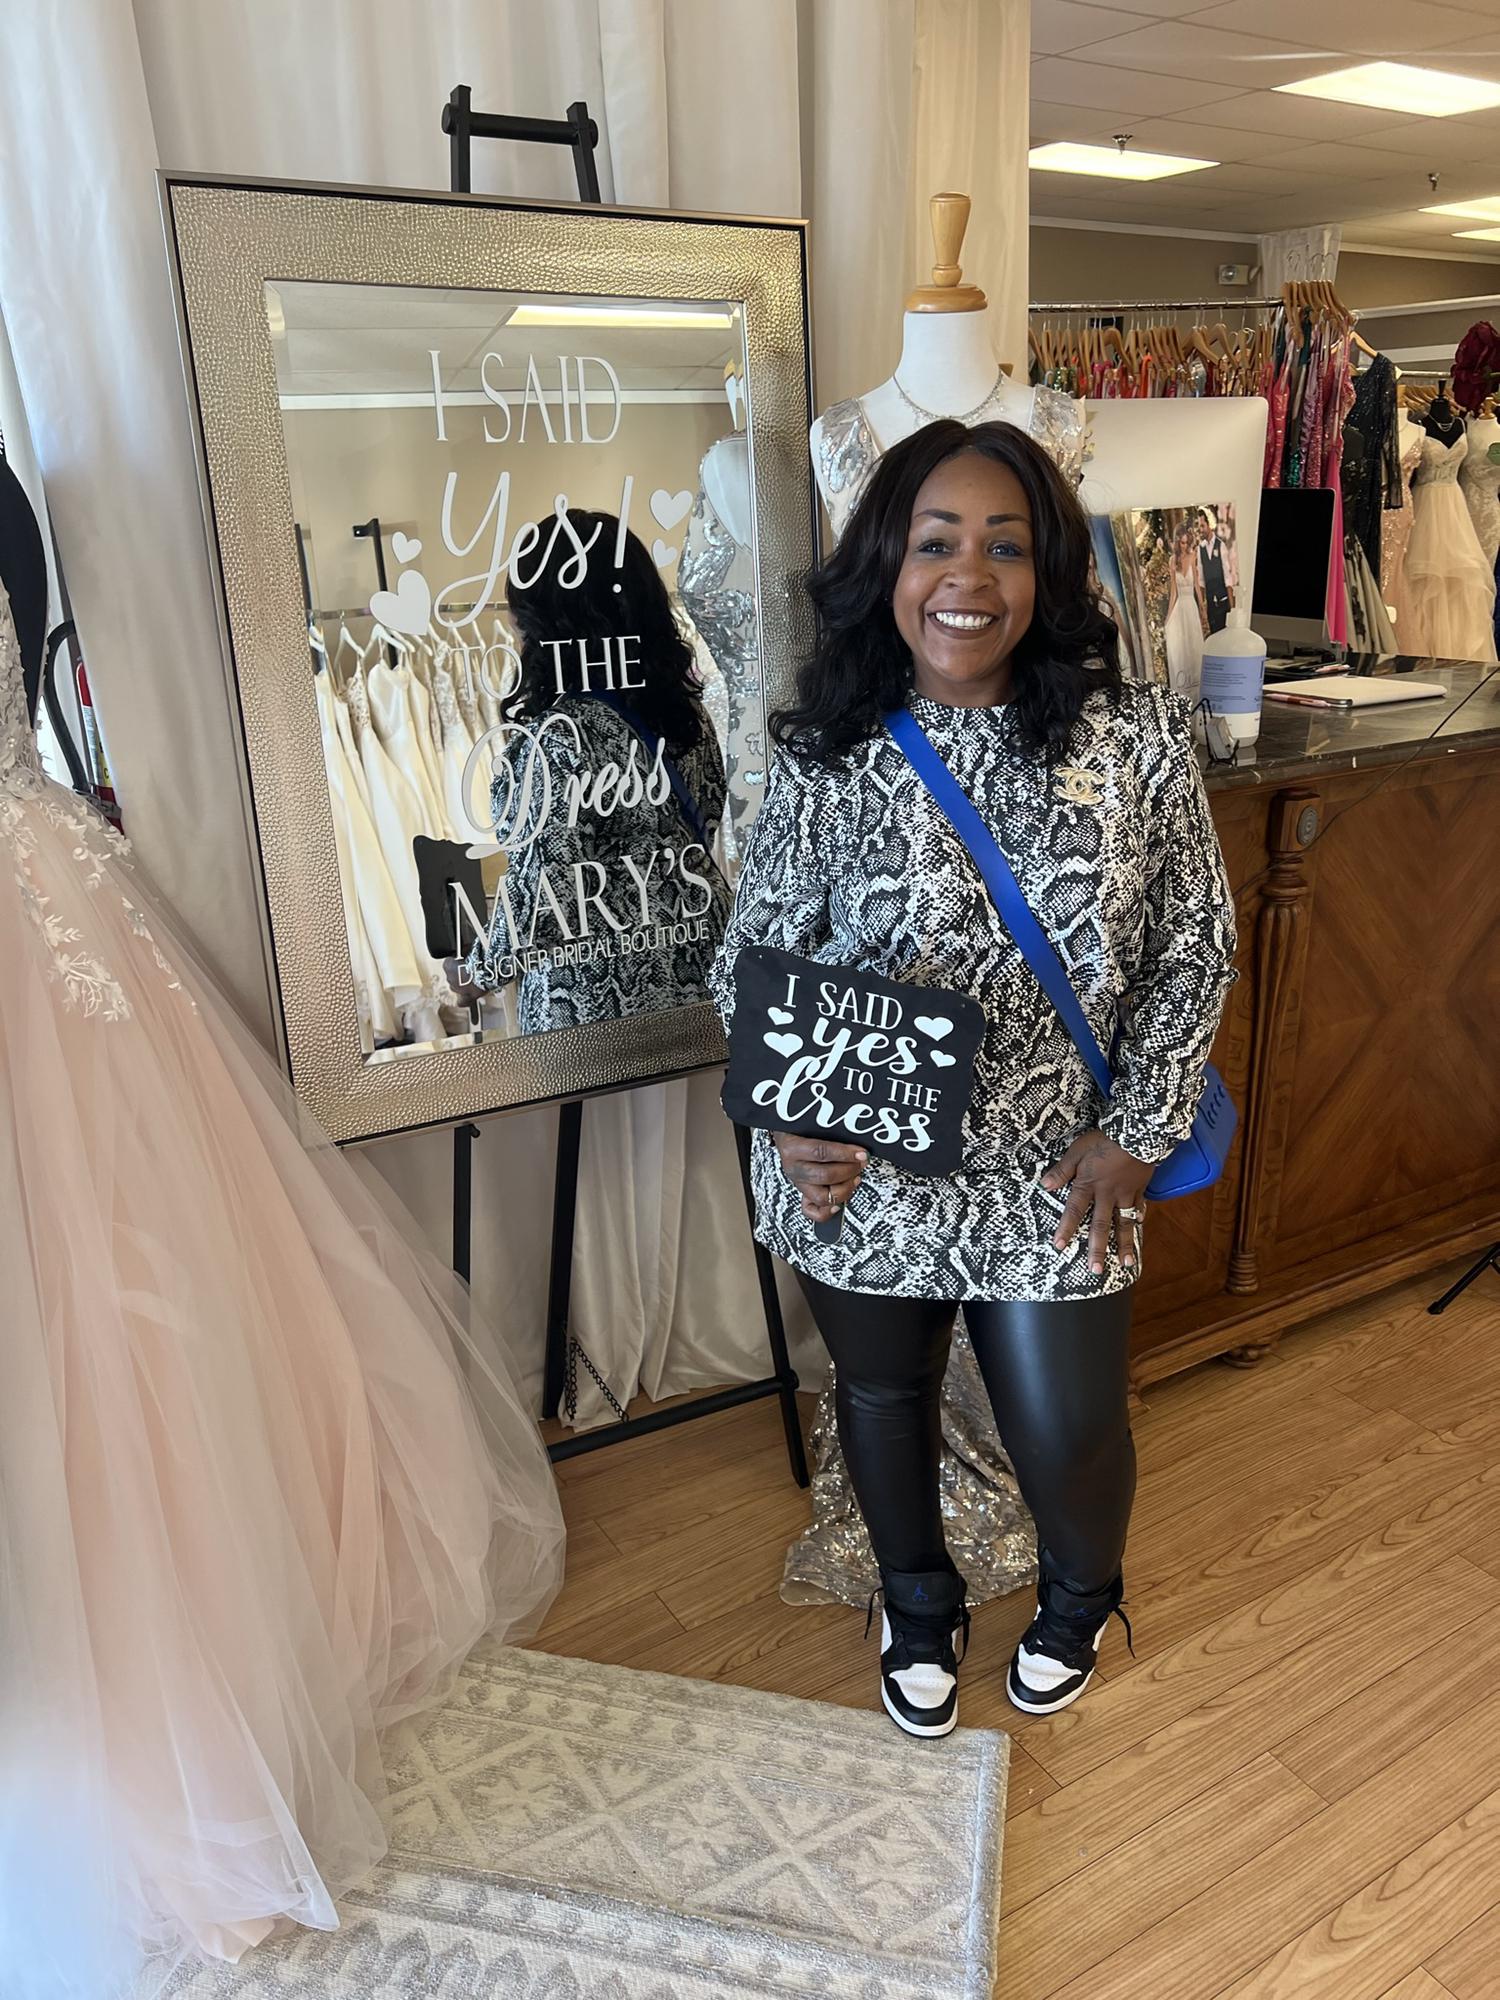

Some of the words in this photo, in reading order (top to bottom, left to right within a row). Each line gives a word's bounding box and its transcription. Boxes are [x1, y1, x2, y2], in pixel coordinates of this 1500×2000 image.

[428, 350, 449, 441] I
[480, 352, 621, 443] SAID
[433, 471, 635, 628] Yes!
[451, 643, 523, 701] TO
[539, 635, 647, 695] THE
[461, 713, 671, 860] Dress
[448, 843, 713, 961] MARY'S
[457, 949, 549, 987] DESIGNER
[553, 937, 617, 968] BRIDAL
[620, 919, 710, 955] BOUTIQUE
[783, 973, 801, 1008] I
[816, 981, 903, 1030] SAID
[805, 1016, 922, 1082] yes
[842, 1066, 874, 1095] TO
[886, 1077, 942, 1112] THE
[751, 1055, 935, 1152] dress
